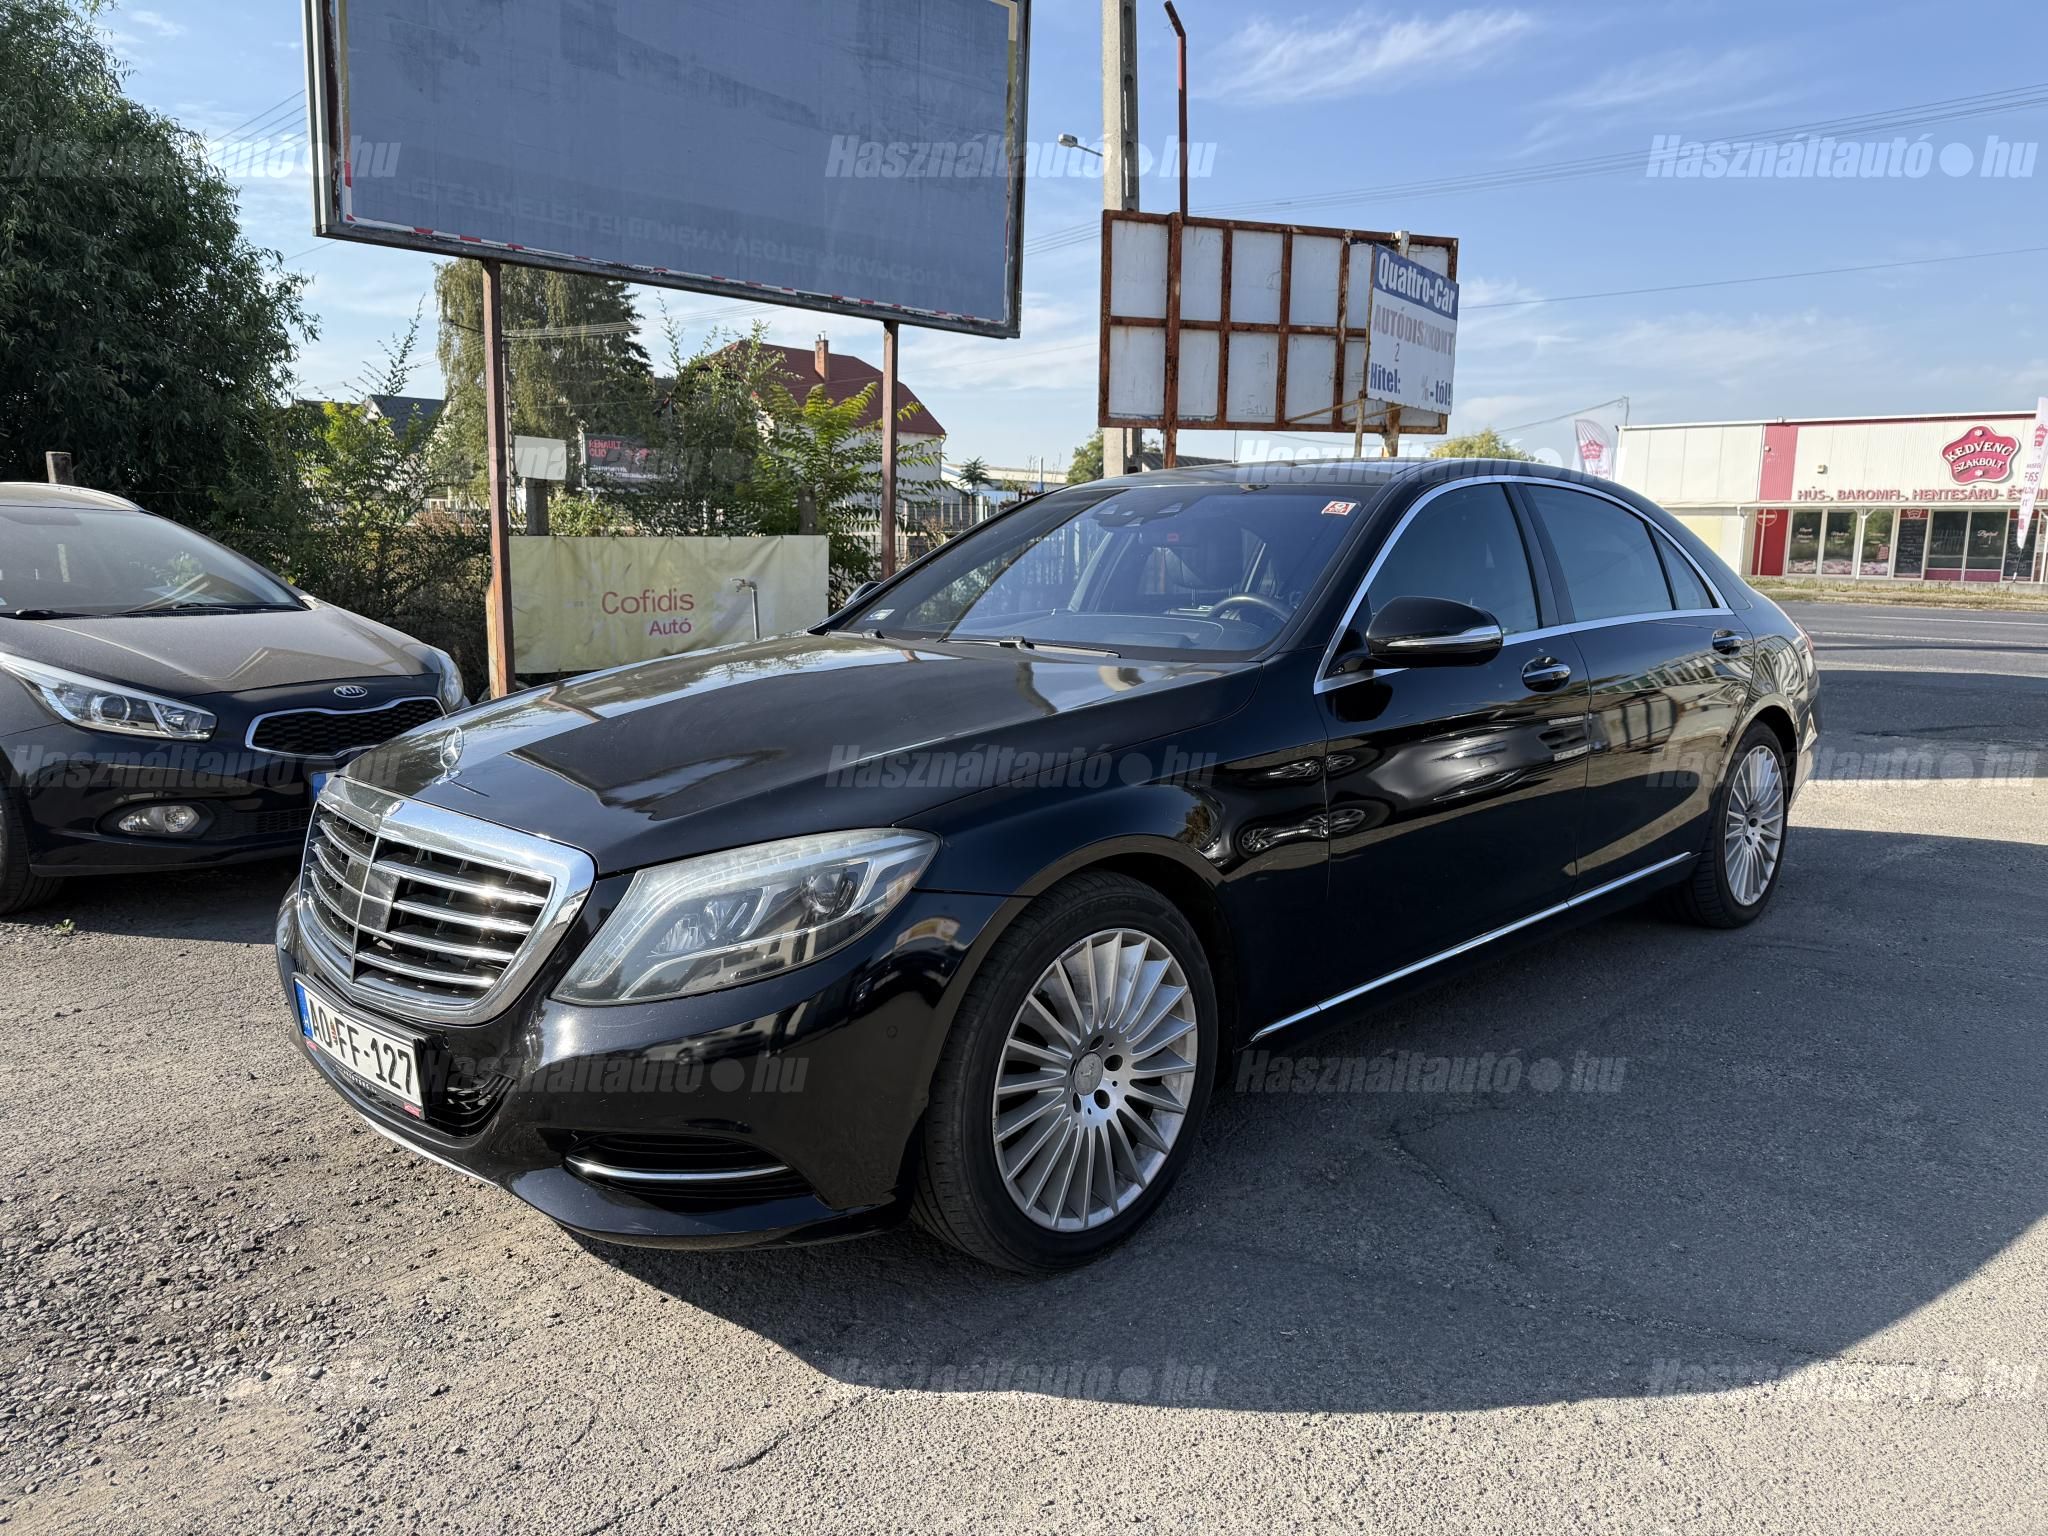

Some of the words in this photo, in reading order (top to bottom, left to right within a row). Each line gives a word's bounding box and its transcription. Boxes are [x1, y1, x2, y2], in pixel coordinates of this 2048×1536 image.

[1378, 252, 1455, 314] Quattro-Car
[1370, 363, 1401, 394] Hitel:
[588, 440, 622, 450] RENAULT
[1944, 441, 2014, 462] KEDVENC
[1955, 457, 2005, 474] SZAKBOLT
[601, 587, 695, 614] Cofidis
[648, 617, 692, 636] Autó
